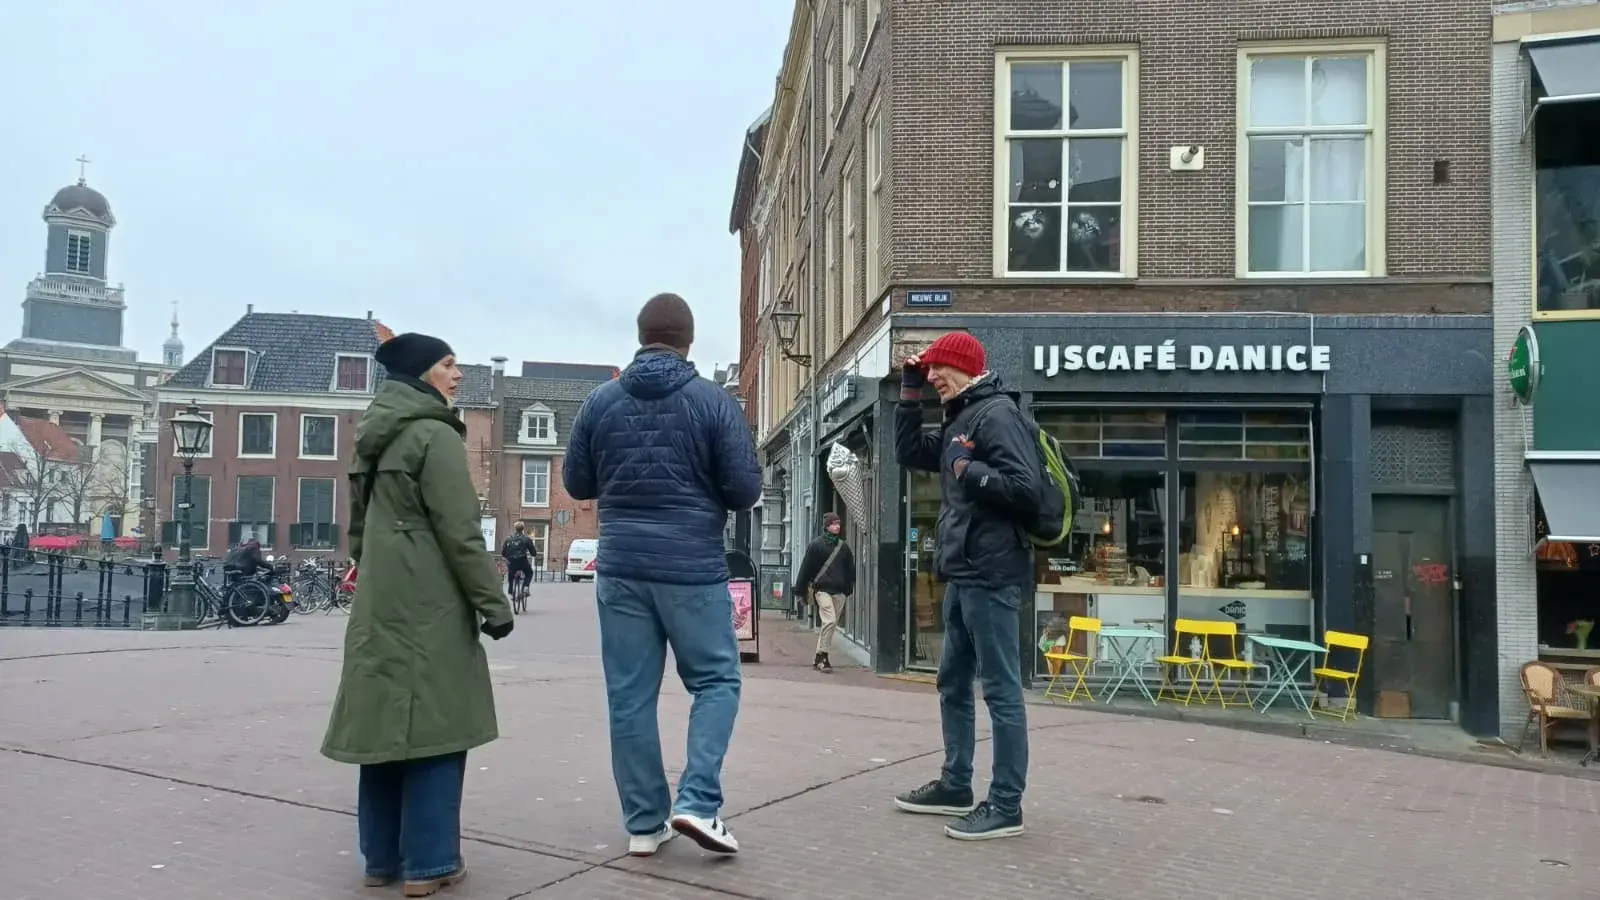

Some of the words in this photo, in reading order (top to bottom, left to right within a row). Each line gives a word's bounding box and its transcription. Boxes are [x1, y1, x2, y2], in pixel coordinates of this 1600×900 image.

[911, 294, 933, 302] NIEUWE
[934, 294, 948, 302] RIJN
[1033, 339, 1177, 377] IJSCAFÉ
[1190, 345, 1331, 371] DANICE
